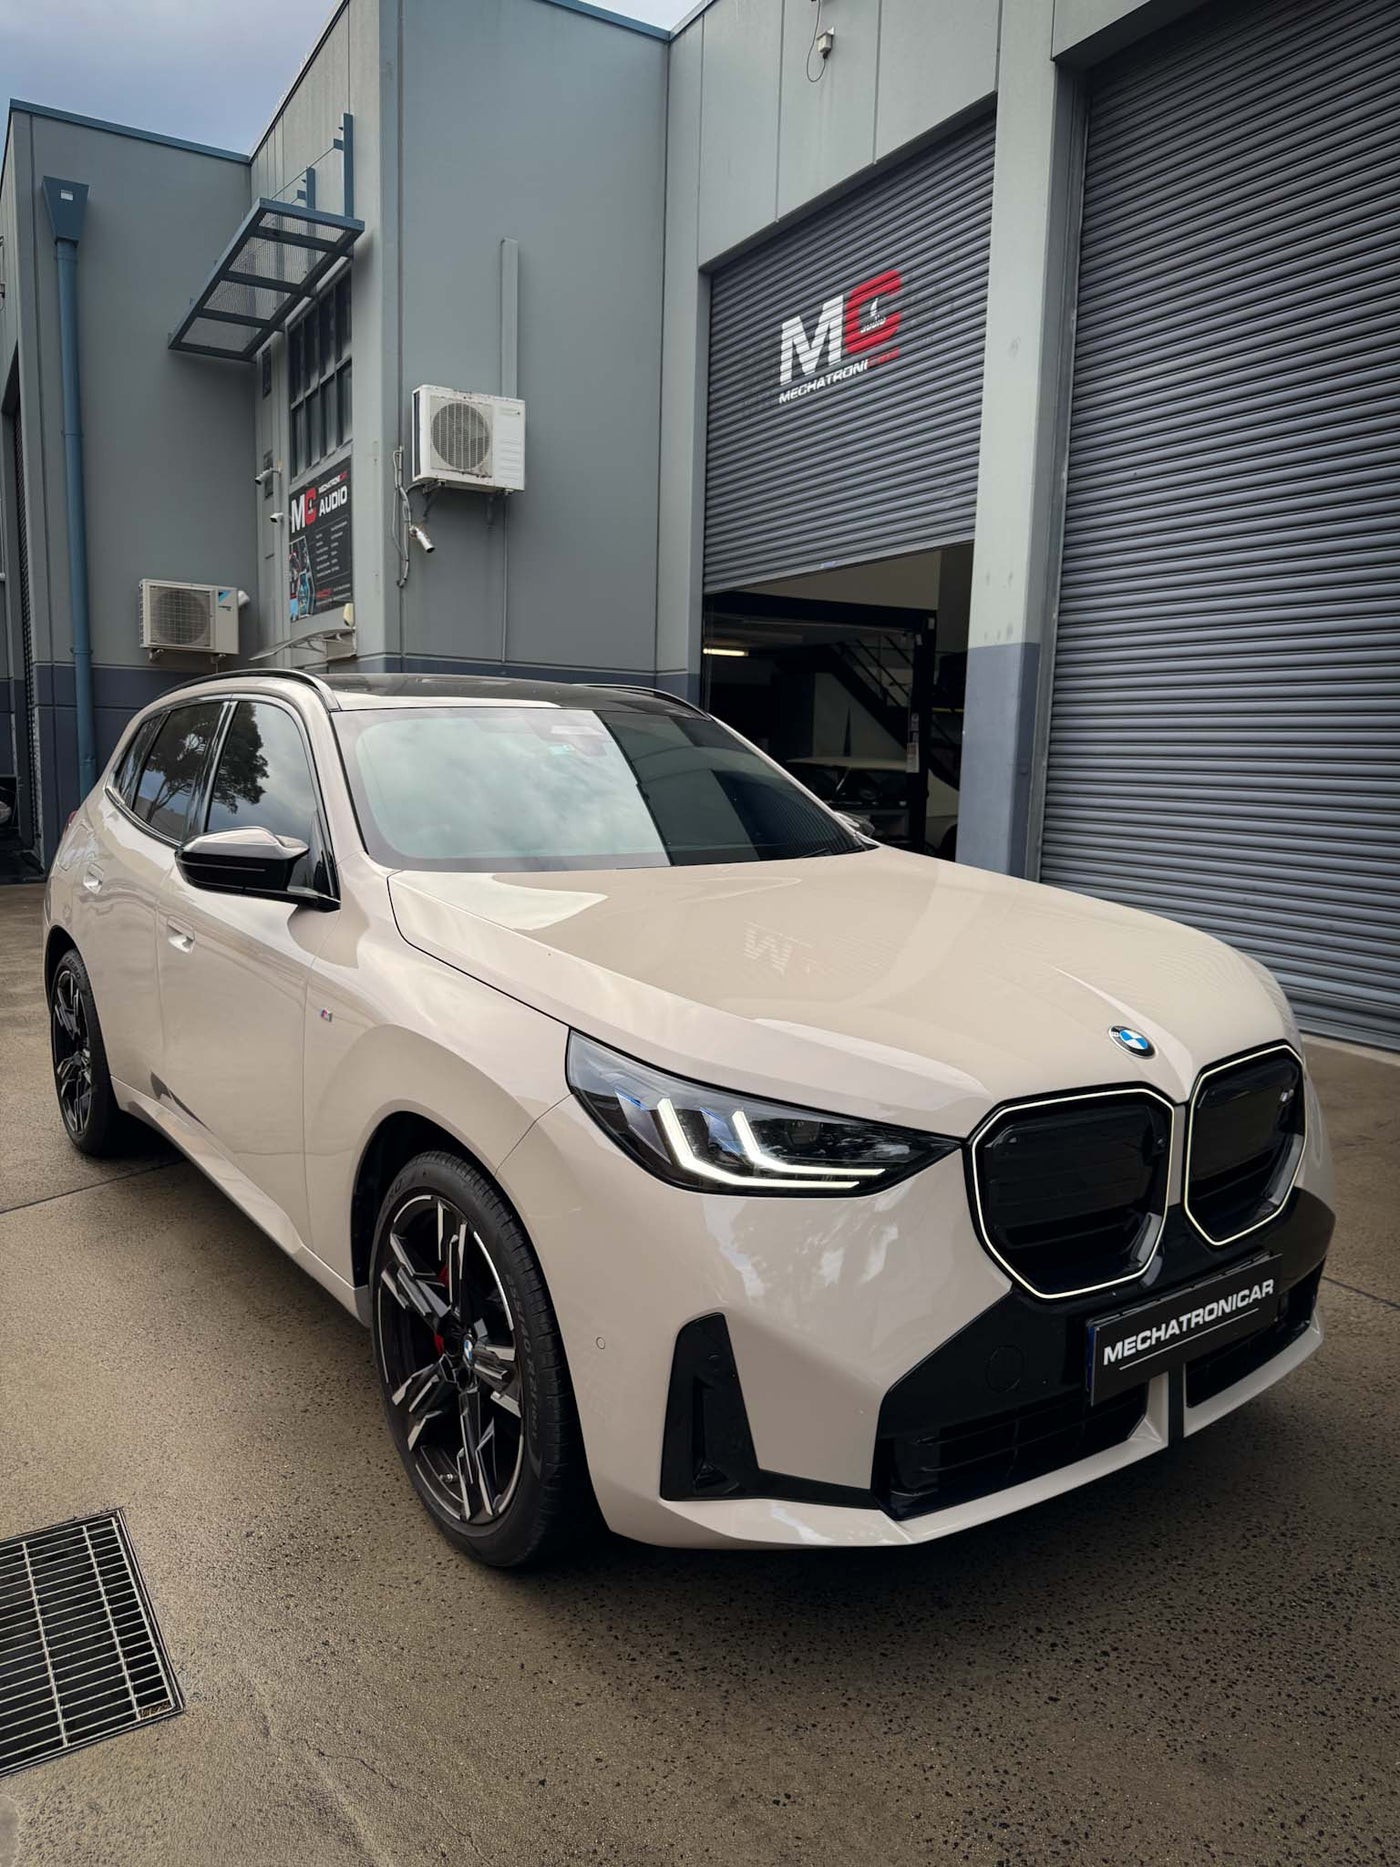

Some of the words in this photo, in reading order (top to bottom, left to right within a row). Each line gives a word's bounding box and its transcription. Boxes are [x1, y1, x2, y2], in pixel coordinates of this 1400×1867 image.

[778, 347, 901, 405] MECHATRONI
[318, 485, 348, 518] AUDIO
[1102, 1278, 1275, 1366] MECHATRONICAR
